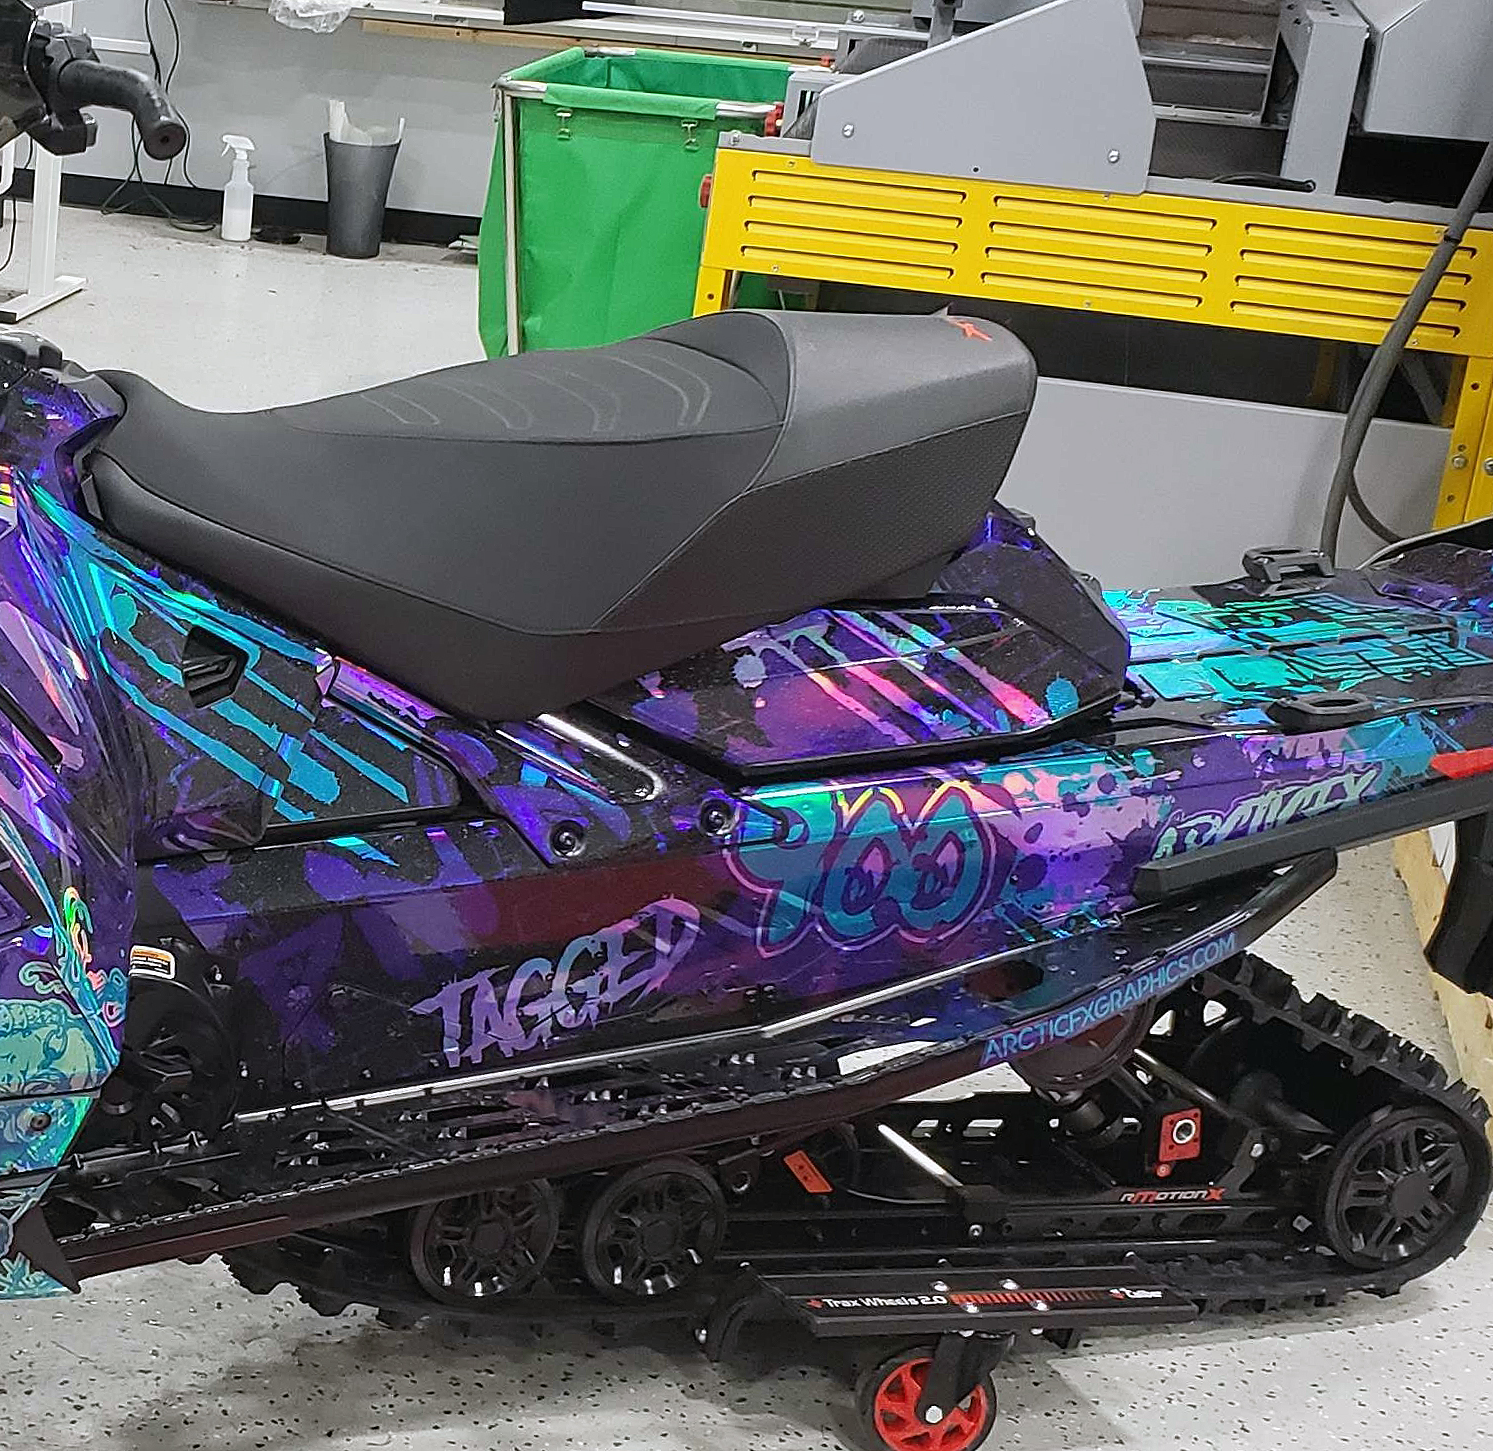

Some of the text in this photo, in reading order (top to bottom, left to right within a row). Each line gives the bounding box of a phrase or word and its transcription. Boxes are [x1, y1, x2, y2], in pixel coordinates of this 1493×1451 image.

[408, 894, 702, 1068] TAGGED
[979, 931, 1237, 1066] ARCTICFXGRAPHICS.COM
[821, 1298, 860, 1308] Trax
[858, 1296, 919, 1307] Wheels
